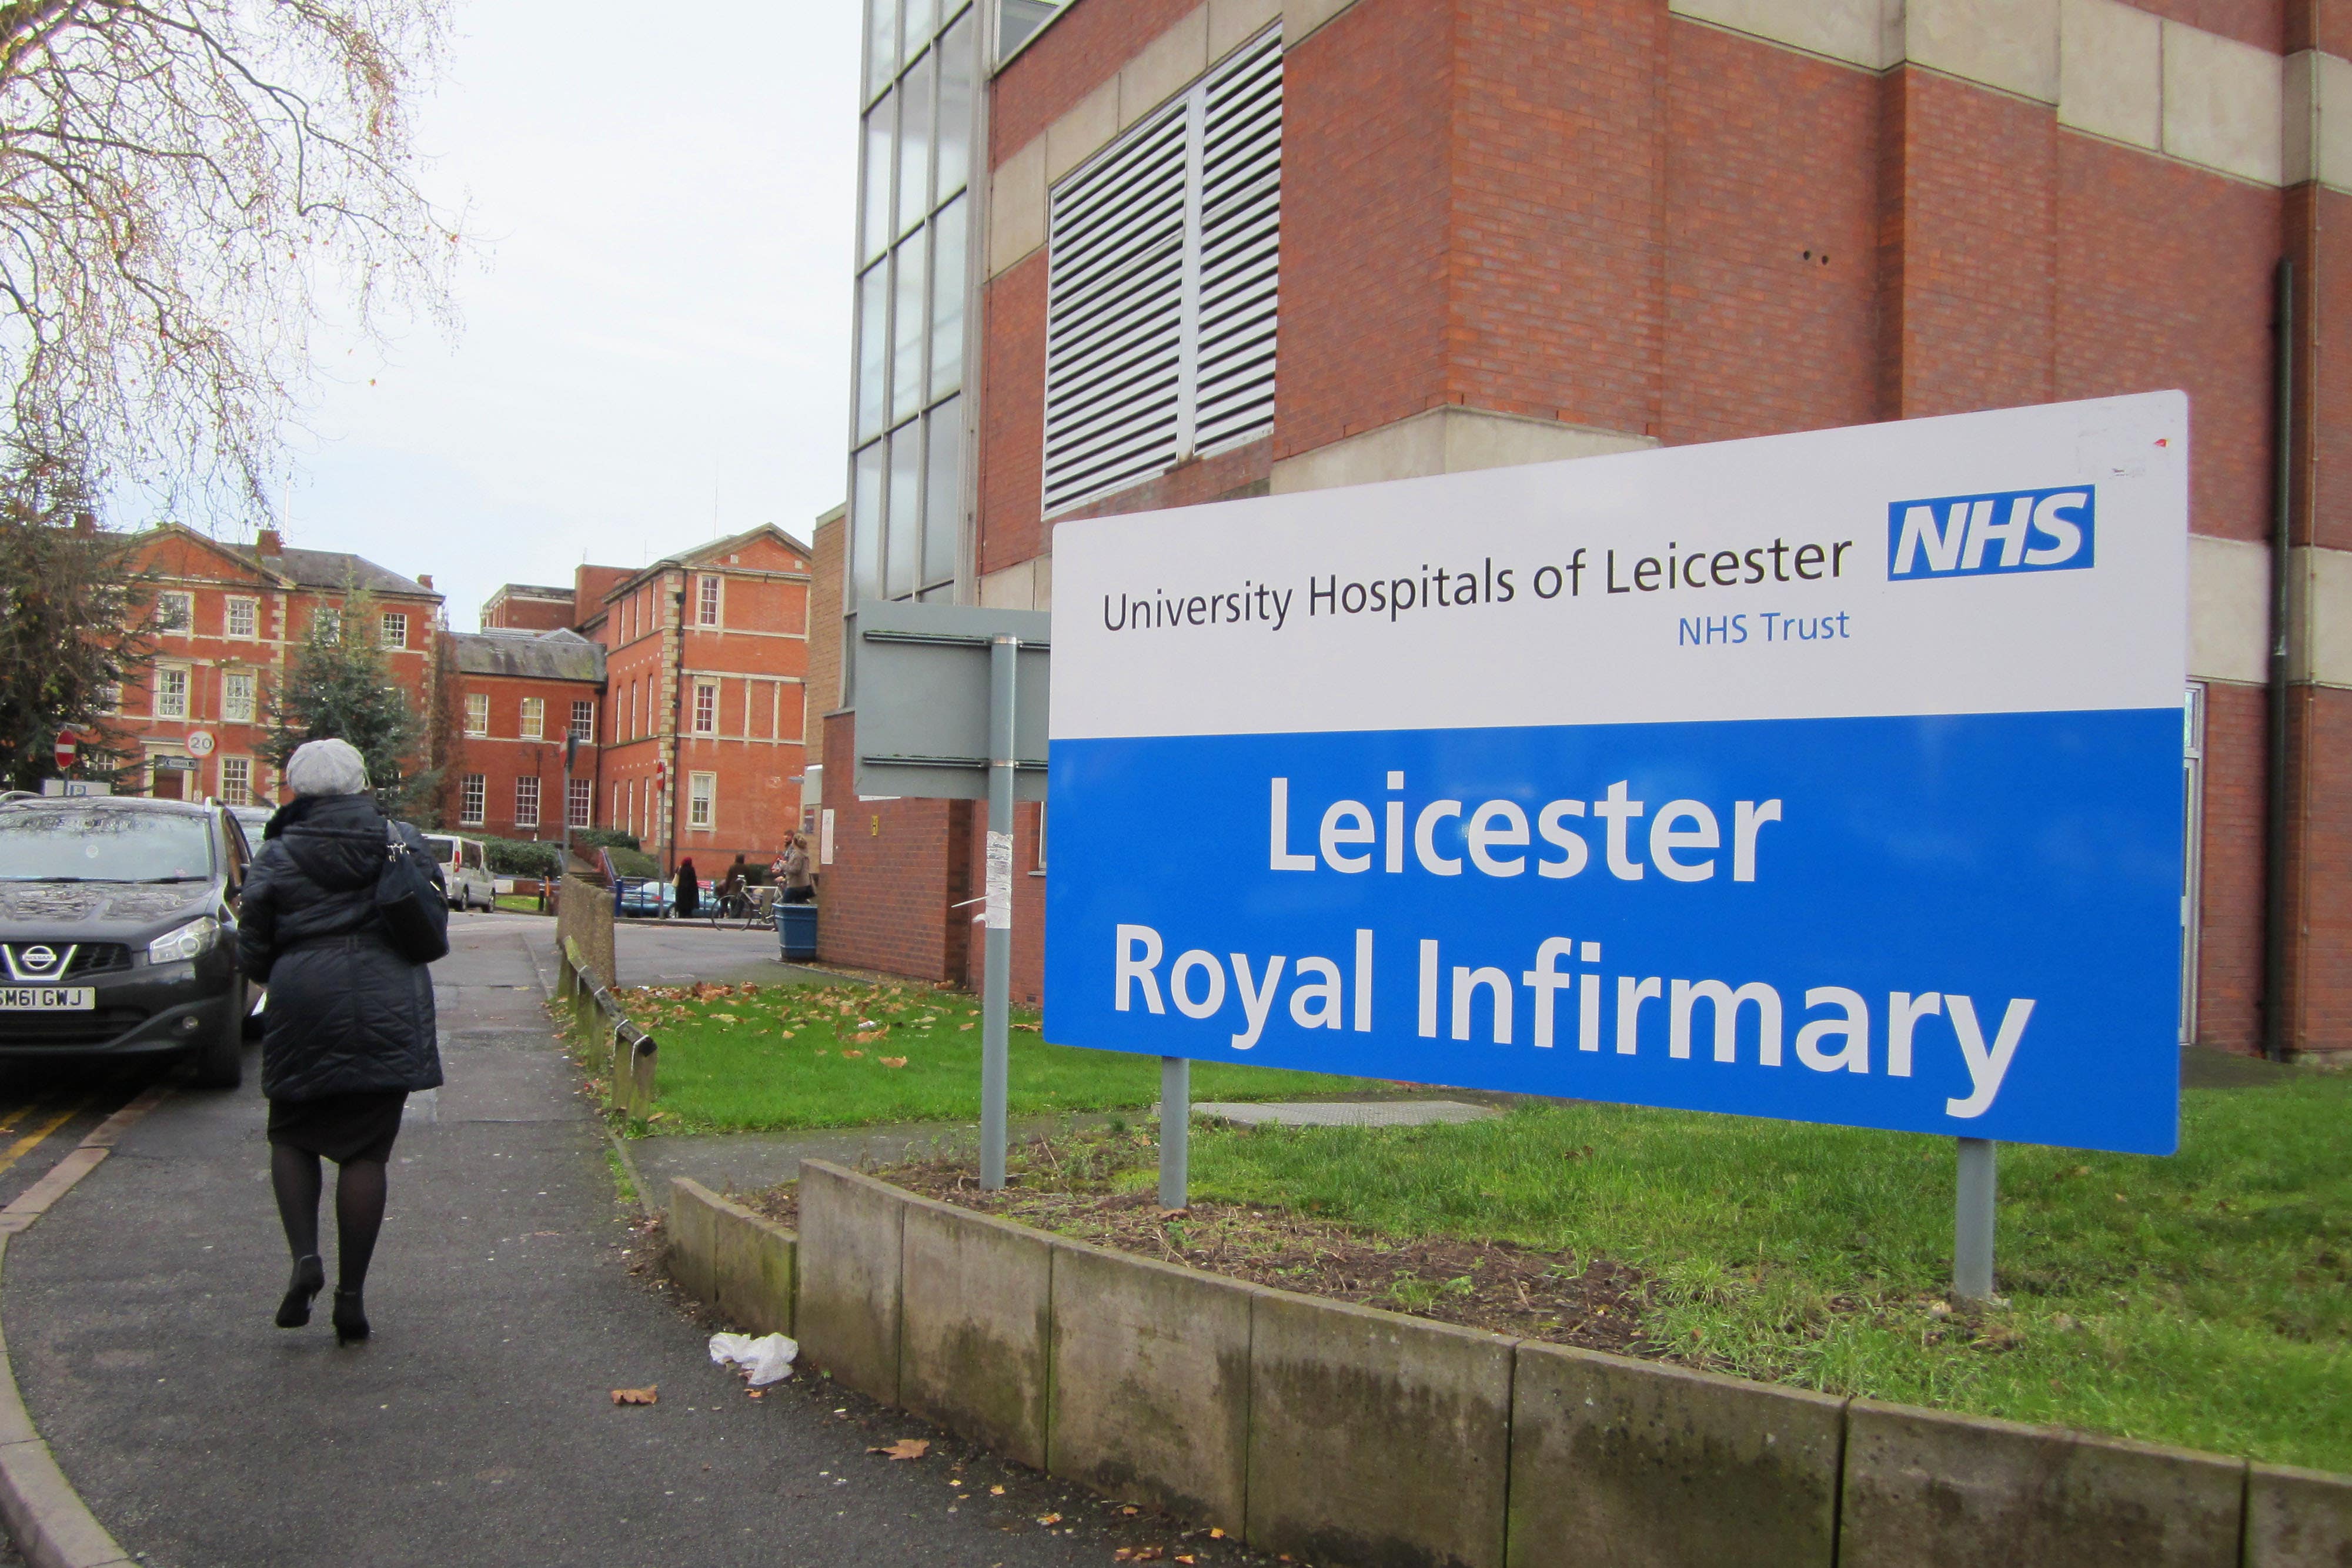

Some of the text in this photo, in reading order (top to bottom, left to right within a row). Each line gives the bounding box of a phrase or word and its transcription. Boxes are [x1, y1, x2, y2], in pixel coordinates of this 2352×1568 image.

[1893, 492, 2089, 574] NHS
[1104, 537, 1852, 631] University Hospitals of Leicester
[1679, 610, 1850, 646] NHS Trust
[190, 736, 212, 750] 20
[1269, 770, 1782, 883] Leicester
[43, 989, 82, 1006] GWJ
[1114, 923, 2036, 1119] Royal Infirmary
